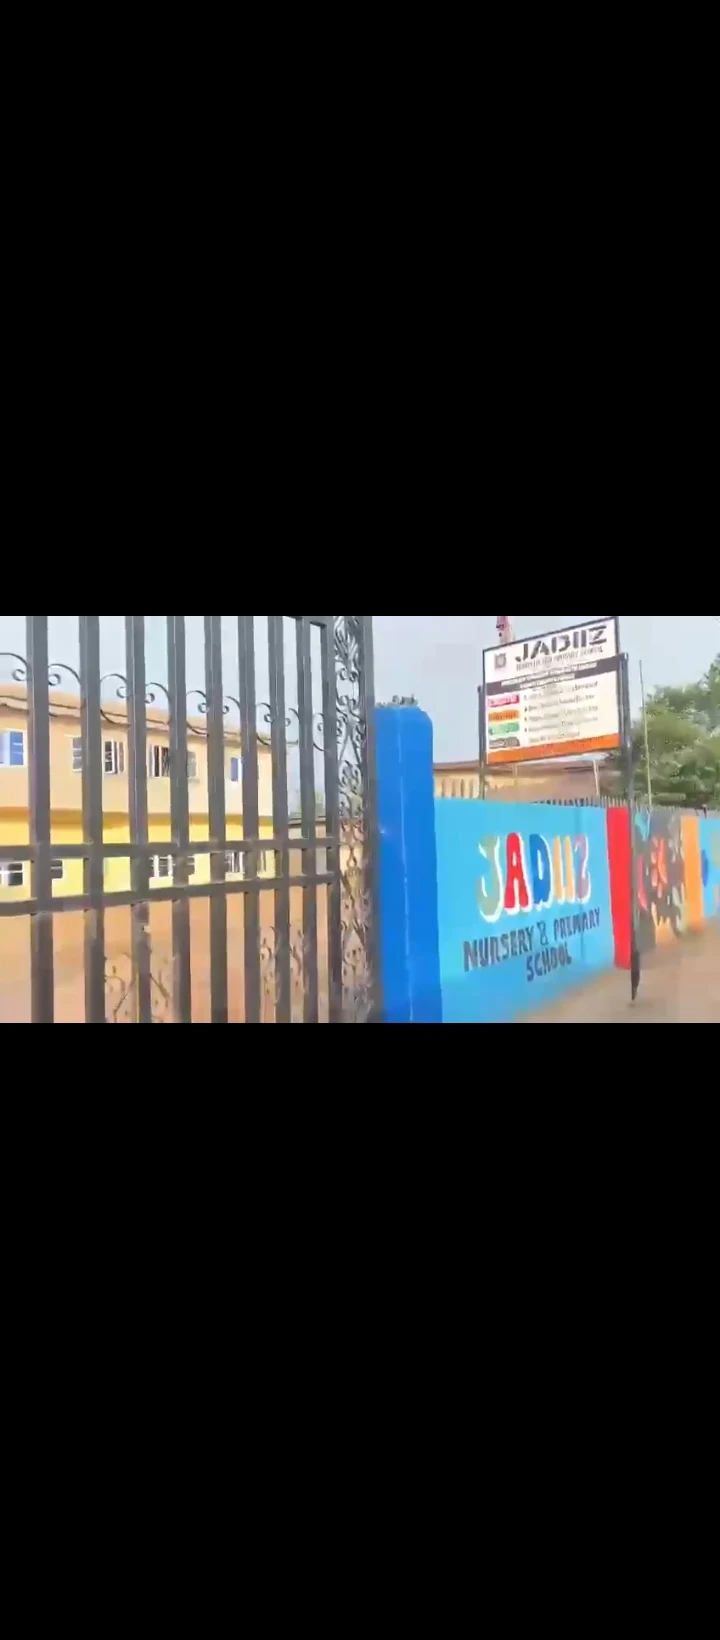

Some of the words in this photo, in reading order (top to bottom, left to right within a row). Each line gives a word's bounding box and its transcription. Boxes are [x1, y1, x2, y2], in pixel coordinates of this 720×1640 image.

[515, 625, 607, 662] JADIIZ
[476, 832, 591, 923] JADIIZ
[463, 925, 534, 972] NURSERY
[553, 908, 601, 940] PRIMARY
[526, 943, 572, 982] SCHOOL
